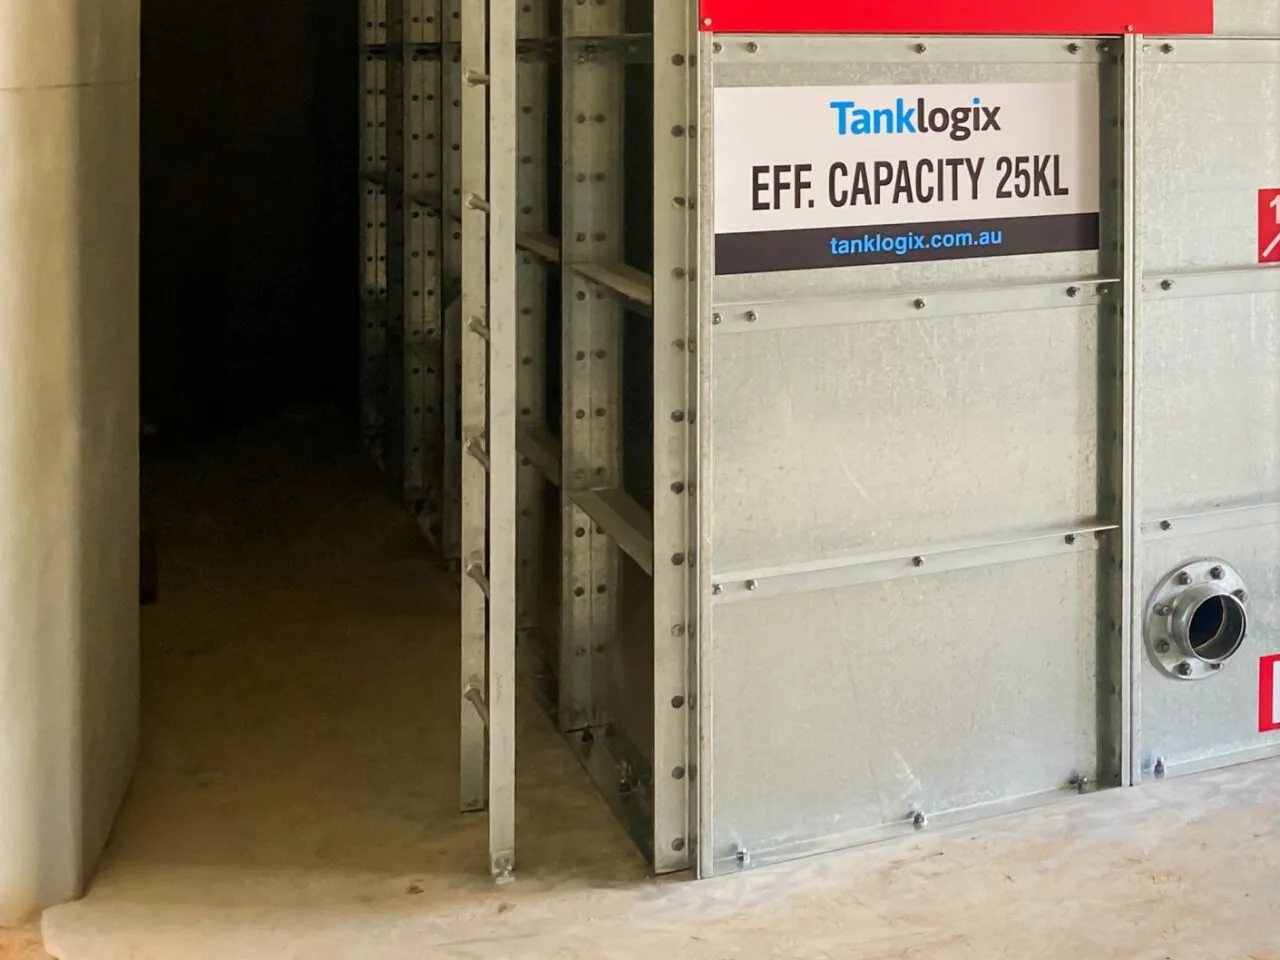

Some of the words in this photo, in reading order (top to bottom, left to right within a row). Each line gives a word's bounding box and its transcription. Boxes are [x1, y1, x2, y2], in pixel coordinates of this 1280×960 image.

[829, 97, 1001, 141] Tanklogix
[751, 164, 815, 212] EFF.
[828, 157, 985, 207] CAPACITY
[995, 153, 1069, 200] 25KL
[829, 227, 1003, 256] tanklogix.com.au
